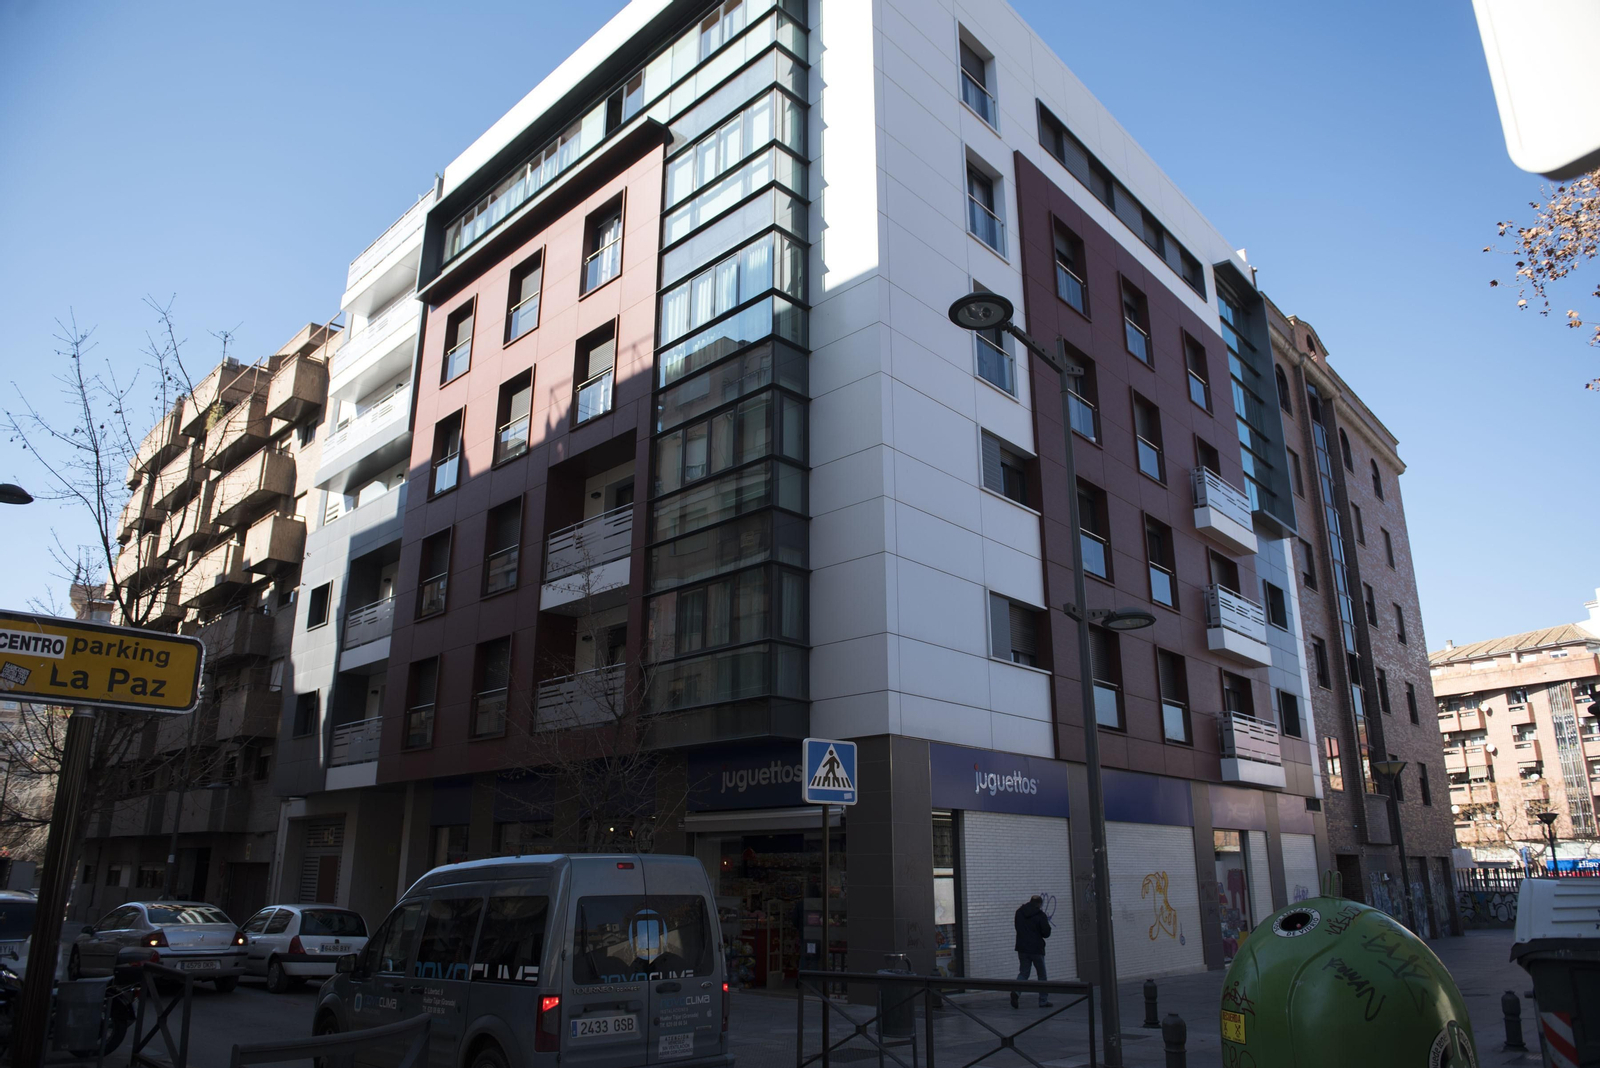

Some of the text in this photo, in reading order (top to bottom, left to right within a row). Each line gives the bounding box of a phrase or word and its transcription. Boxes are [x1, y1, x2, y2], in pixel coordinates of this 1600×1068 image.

[0, 632, 64, 655] CENTRO
[71, 637, 171, 668] parking
[50, 662, 90, 690] La
[107, 667, 167, 698] Paz
[720, 760, 803, 794] juguettos
[974, 763, 1038, 796] juguettos
[1299, 918, 1319, 934] VIDRIO
[573, 986, 614, 996] TOURNEO
[581, 1018, 634, 1035] 2433 GSB
